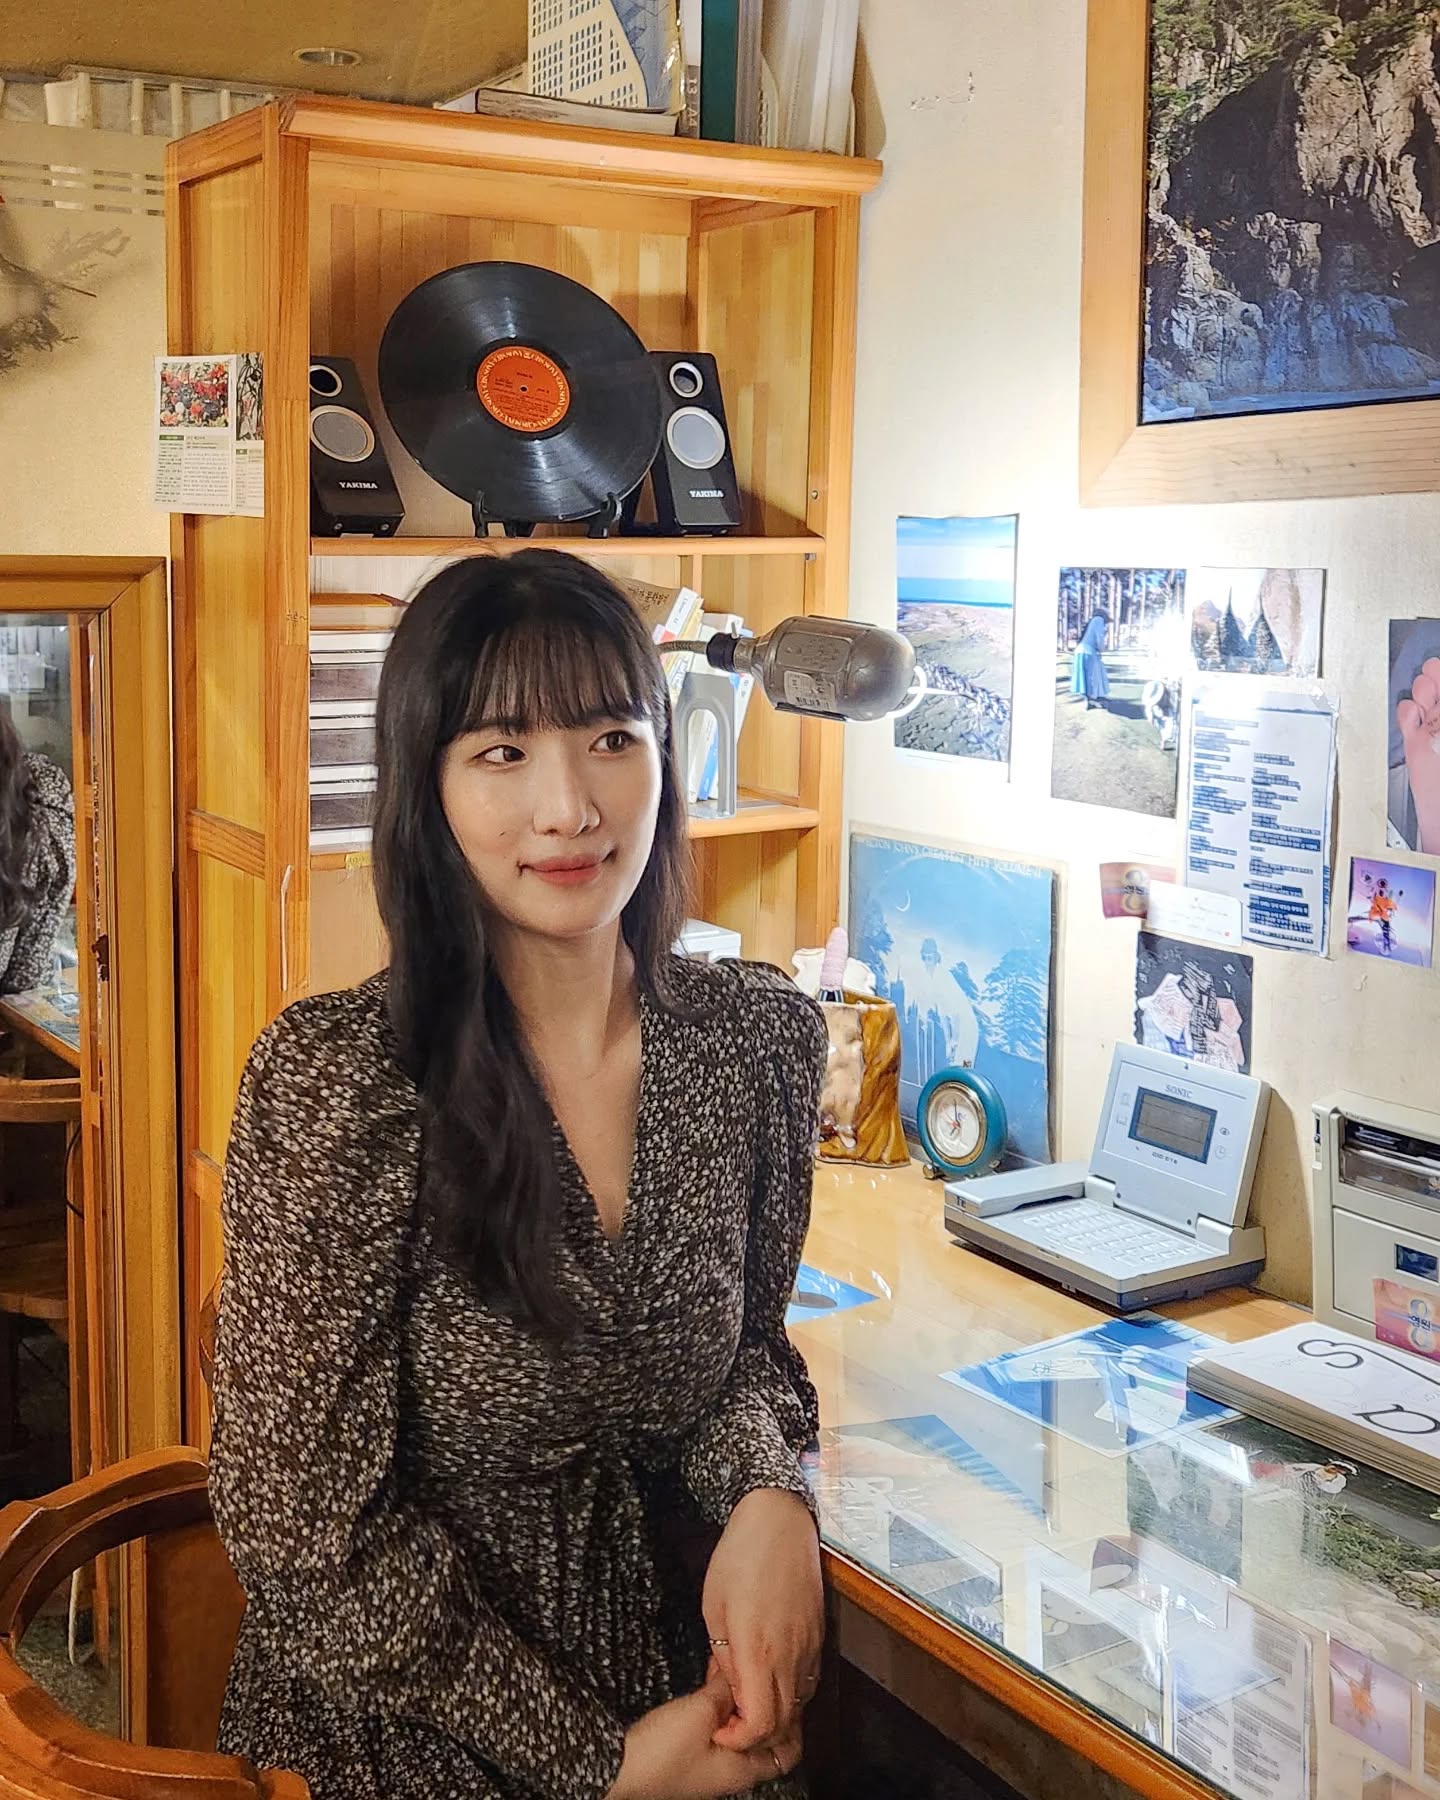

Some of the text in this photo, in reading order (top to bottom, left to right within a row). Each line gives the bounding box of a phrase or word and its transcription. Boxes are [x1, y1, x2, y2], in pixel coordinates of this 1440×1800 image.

[338, 481, 379, 489] YAKIMA
[688, 489, 725, 498] YAKIMA
[1165, 1084, 1193, 1099] SONIC
